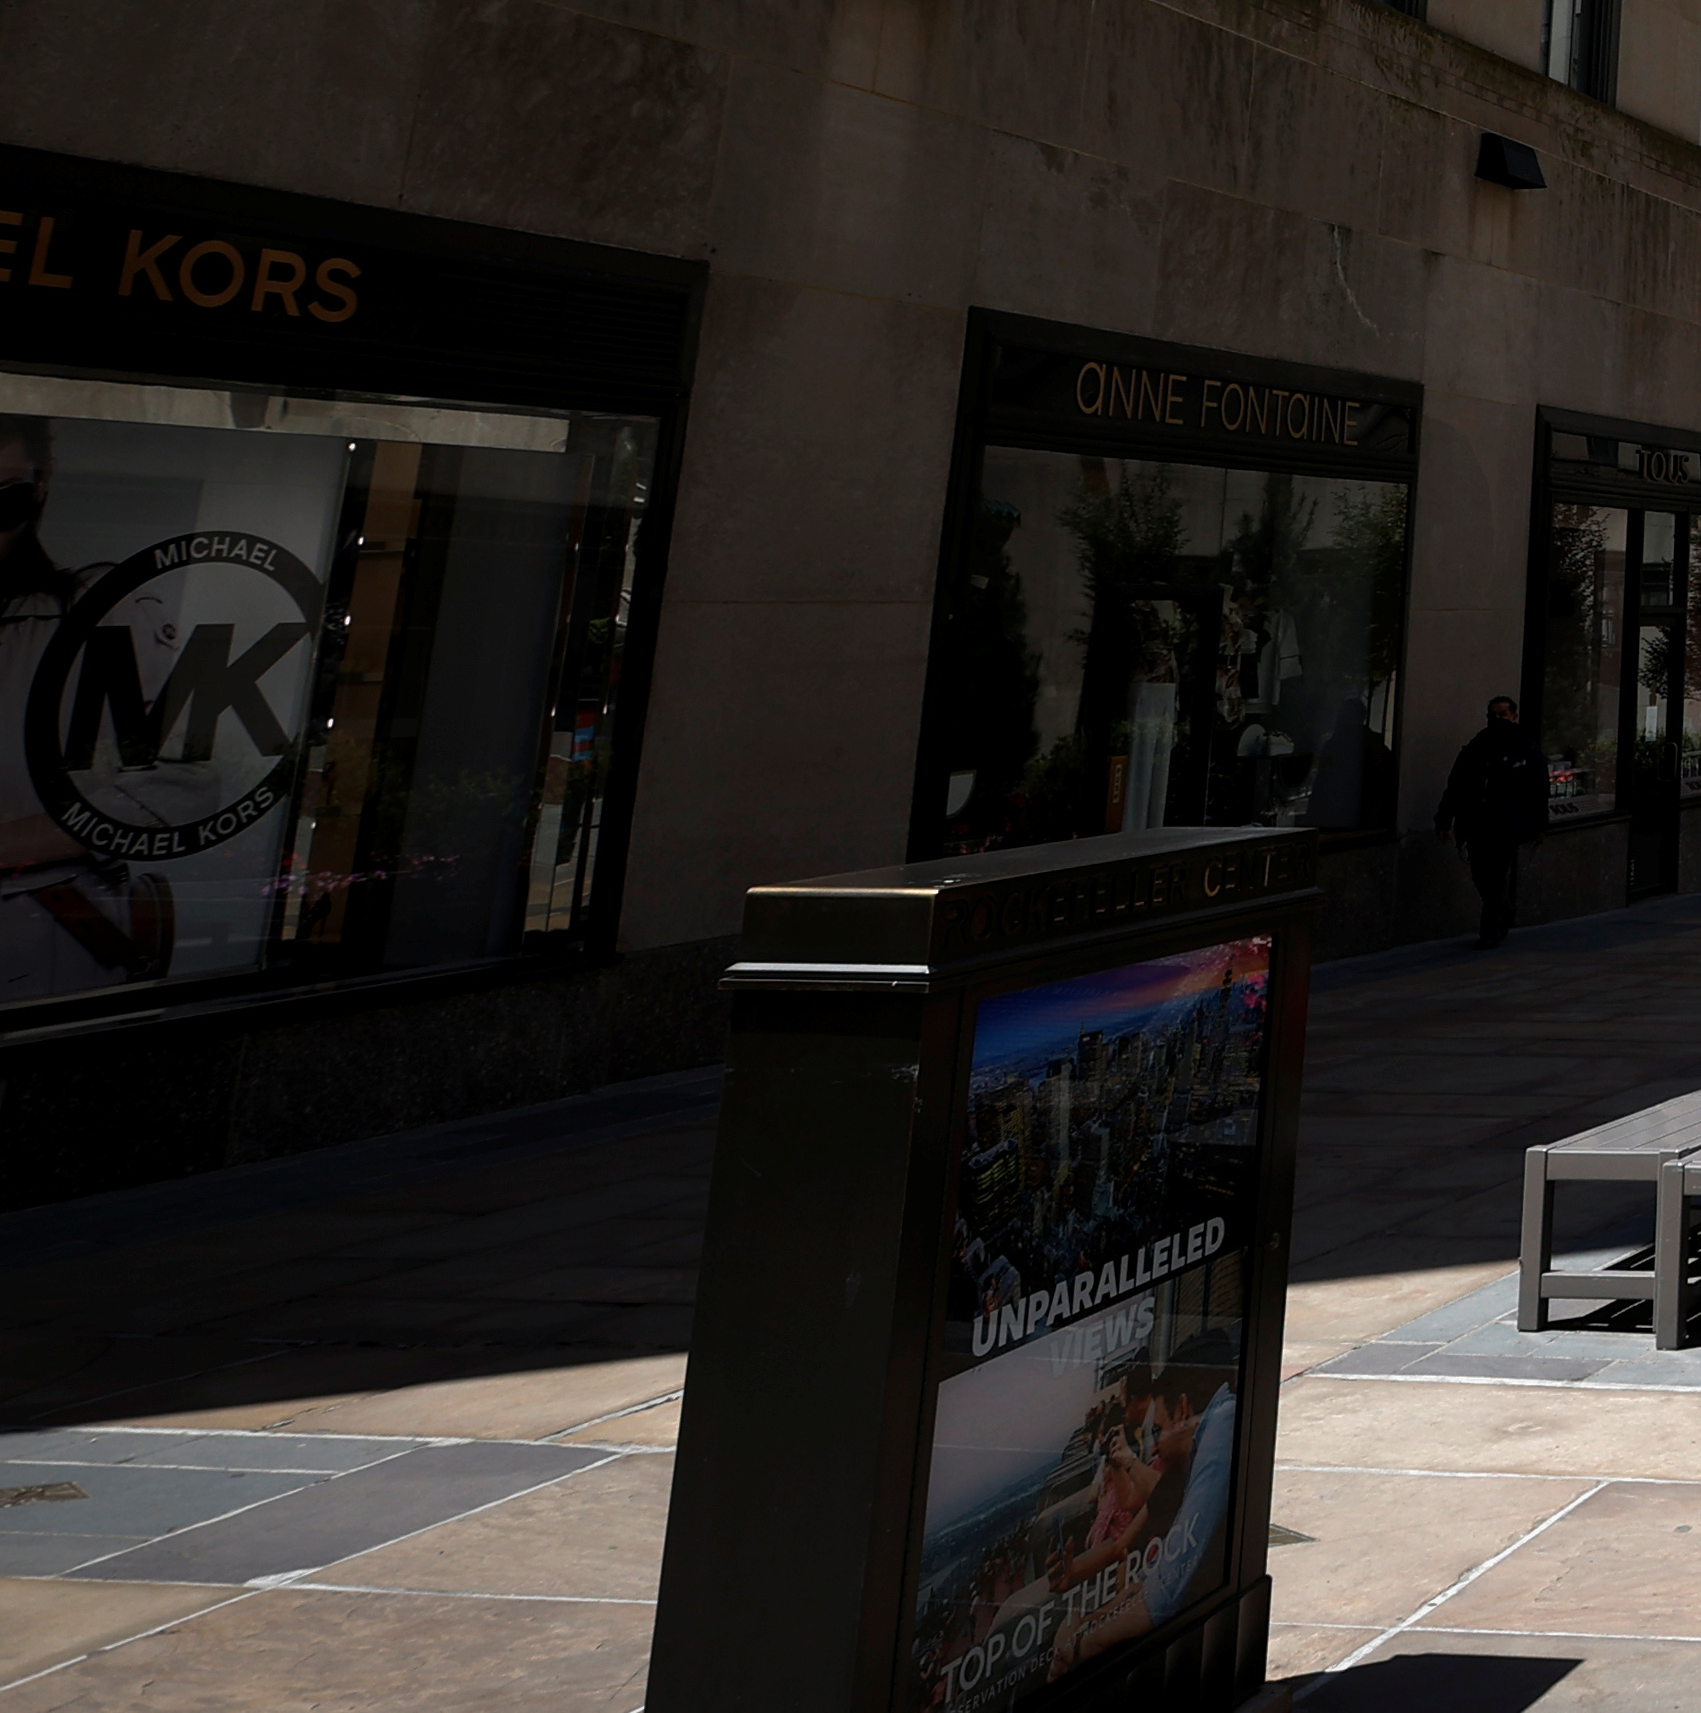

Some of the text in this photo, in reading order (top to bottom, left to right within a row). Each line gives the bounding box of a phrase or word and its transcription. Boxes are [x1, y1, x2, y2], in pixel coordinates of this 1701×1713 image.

[117, 228, 364, 324] KORS
[1637, 449, 1690, 484] TOUS
[153, 536, 279, 572] MICHAEL
[64, 622, 312, 773] MK
[61, 785, 277, 857] MICHAEL KORS
[942, 840, 1311, 948] ROCKEFELLER CENTER
[971, 1216, 1226, 1358] UNPARALLELED
[1048, 1296, 1155, 1379] VIEWS
[940, 1513, 1200, 1704] TOP OF THE ROCK
